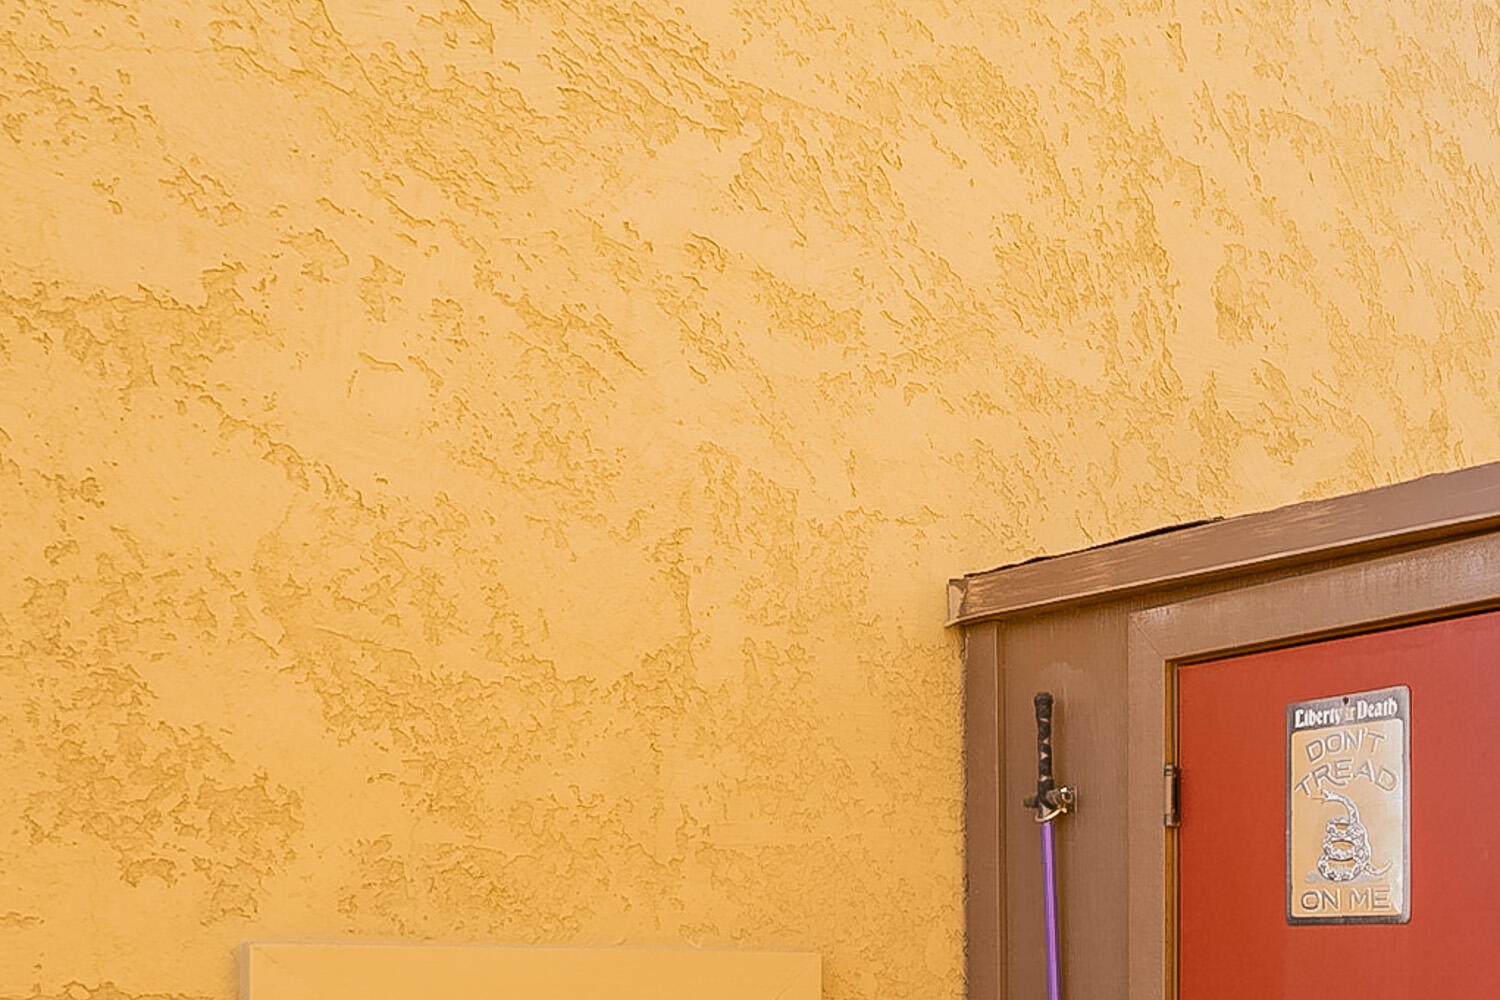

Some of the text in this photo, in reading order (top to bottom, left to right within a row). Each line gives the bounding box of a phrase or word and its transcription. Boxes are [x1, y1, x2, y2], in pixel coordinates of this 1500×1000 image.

[1295, 708, 1342, 728] Liberty
[1356, 697, 1398, 720] Death
[1305, 728, 1385, 763] DON'T
[1294, 757, 1398, 798] TREAD
[1301, 887, 1391, 912] ON ME
